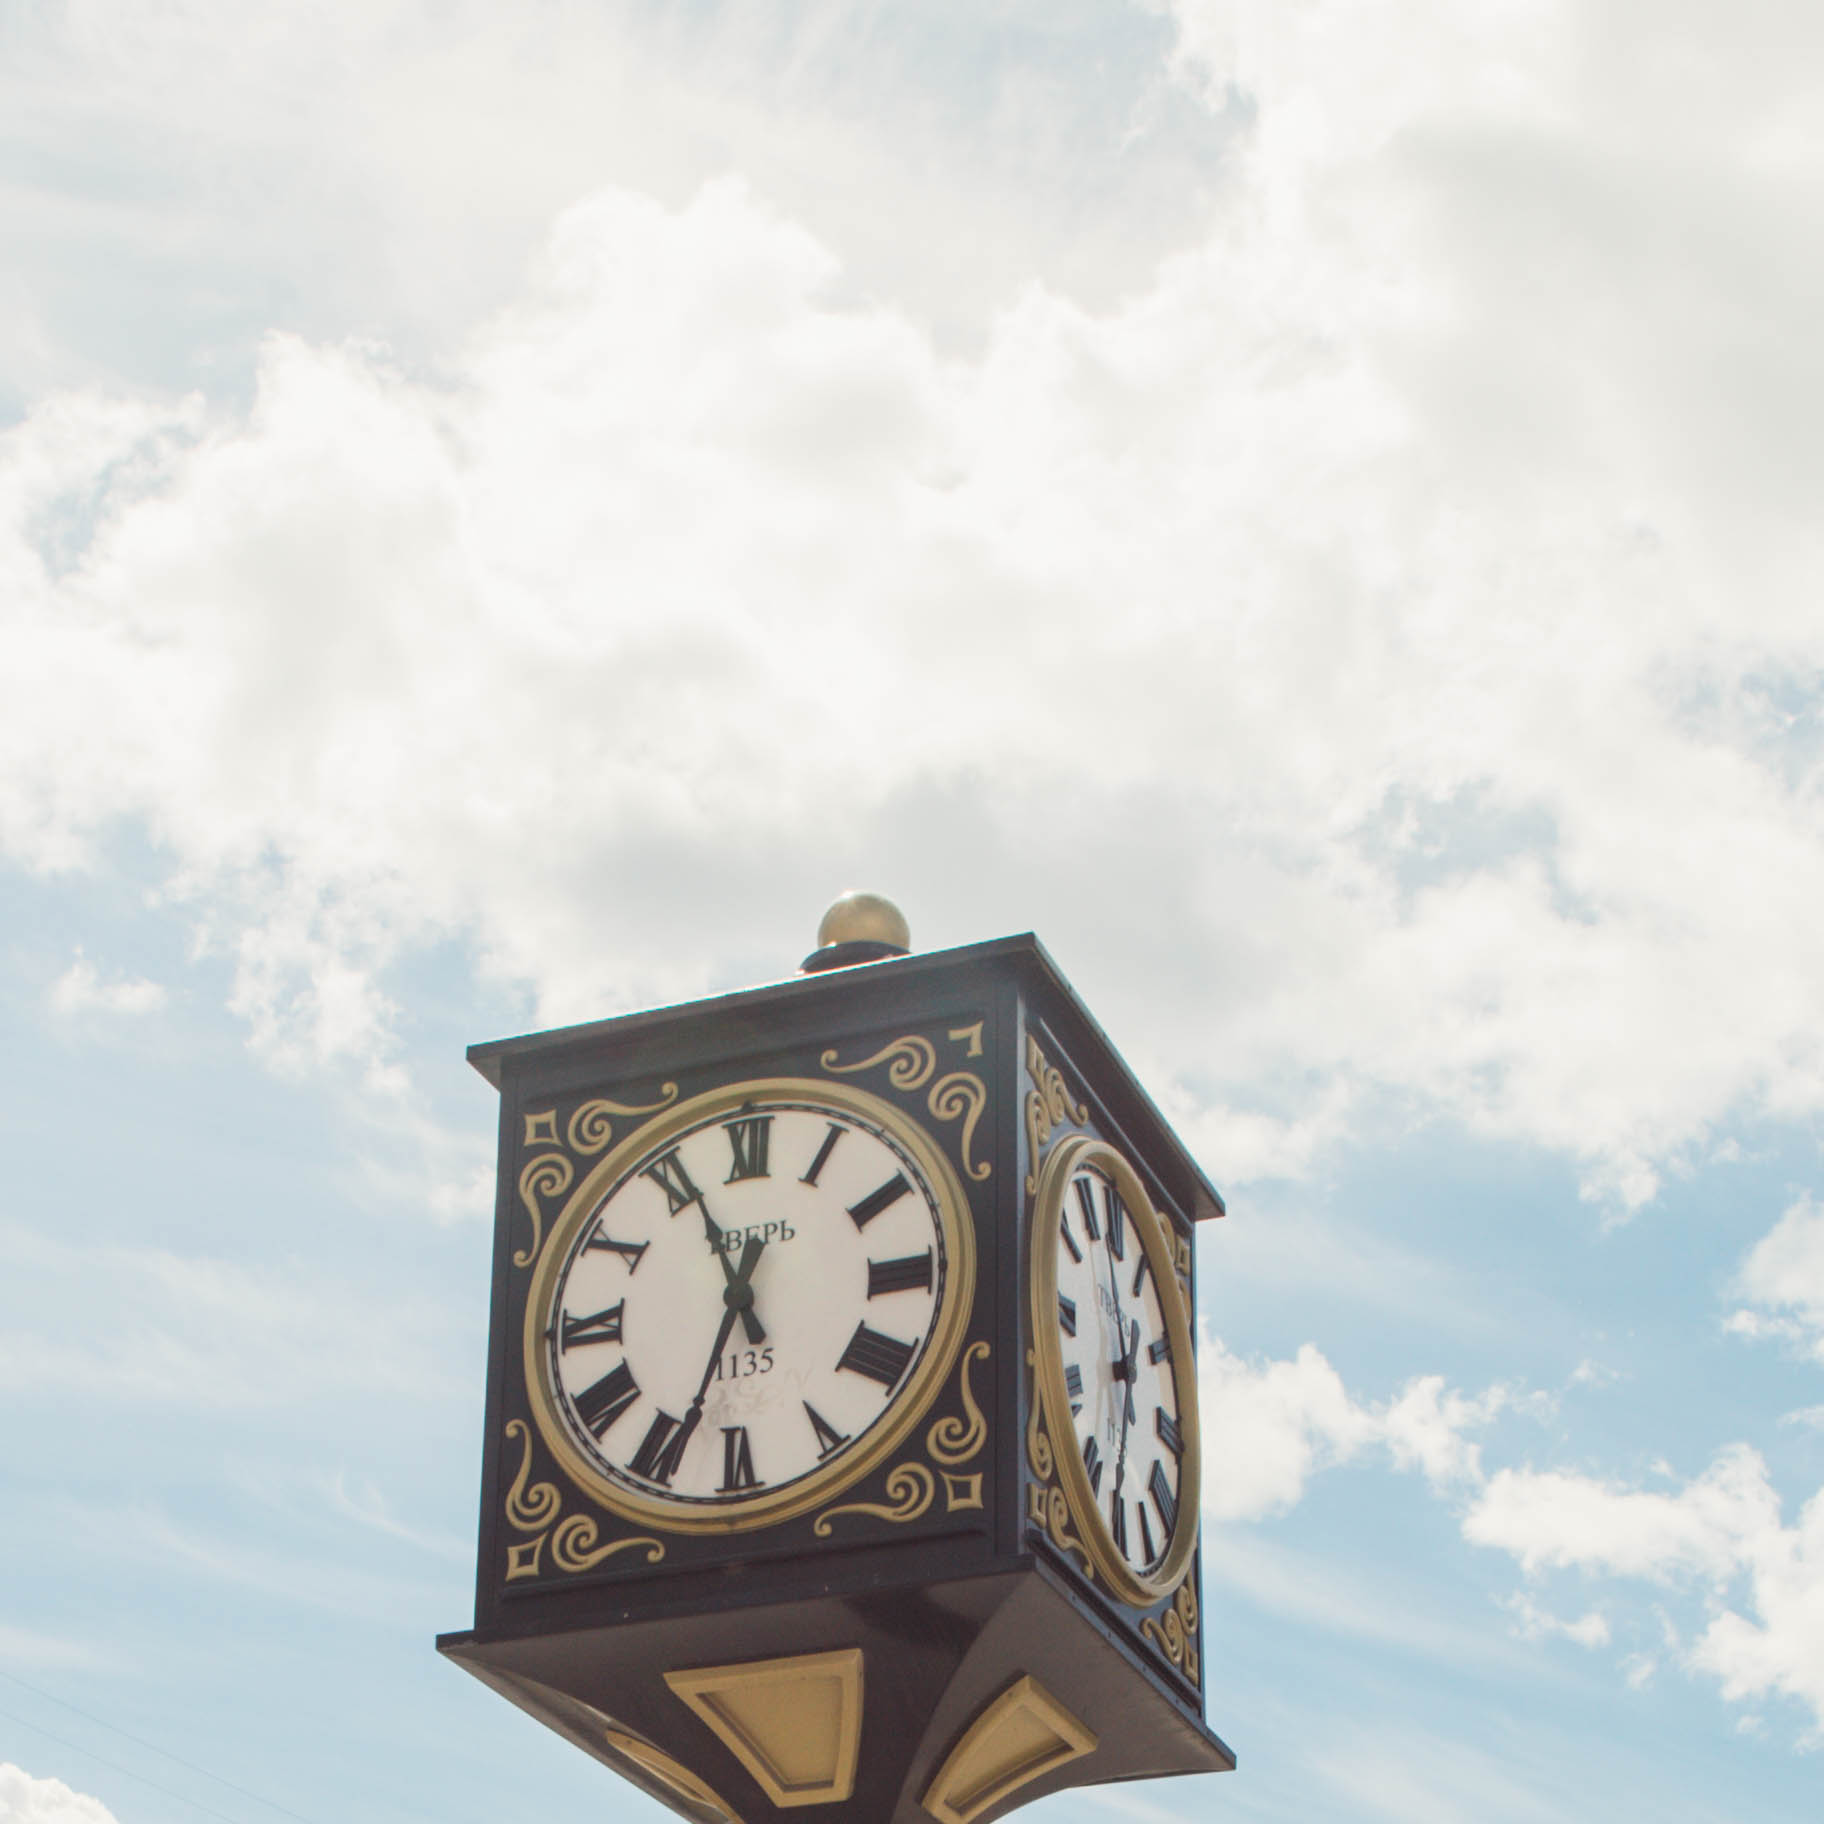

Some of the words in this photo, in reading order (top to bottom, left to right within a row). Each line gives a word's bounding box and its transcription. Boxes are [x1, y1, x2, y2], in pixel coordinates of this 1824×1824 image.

[722, 1115, 775, 1185] XII
[798, 1121, 849, 1188] I
[846, 1169, 915, 1234] II
[581, 1218, 651, 1276] X
[867, 1244, 933, 1301] III
[562, 1297, 625, 1355] IX
[714, 1347, 775, 1382] 1135
[570, 1357, 642, 1444] VIII
[802, 1400, 852, 1461] V
[714, 1426, 766, 1493] VI
